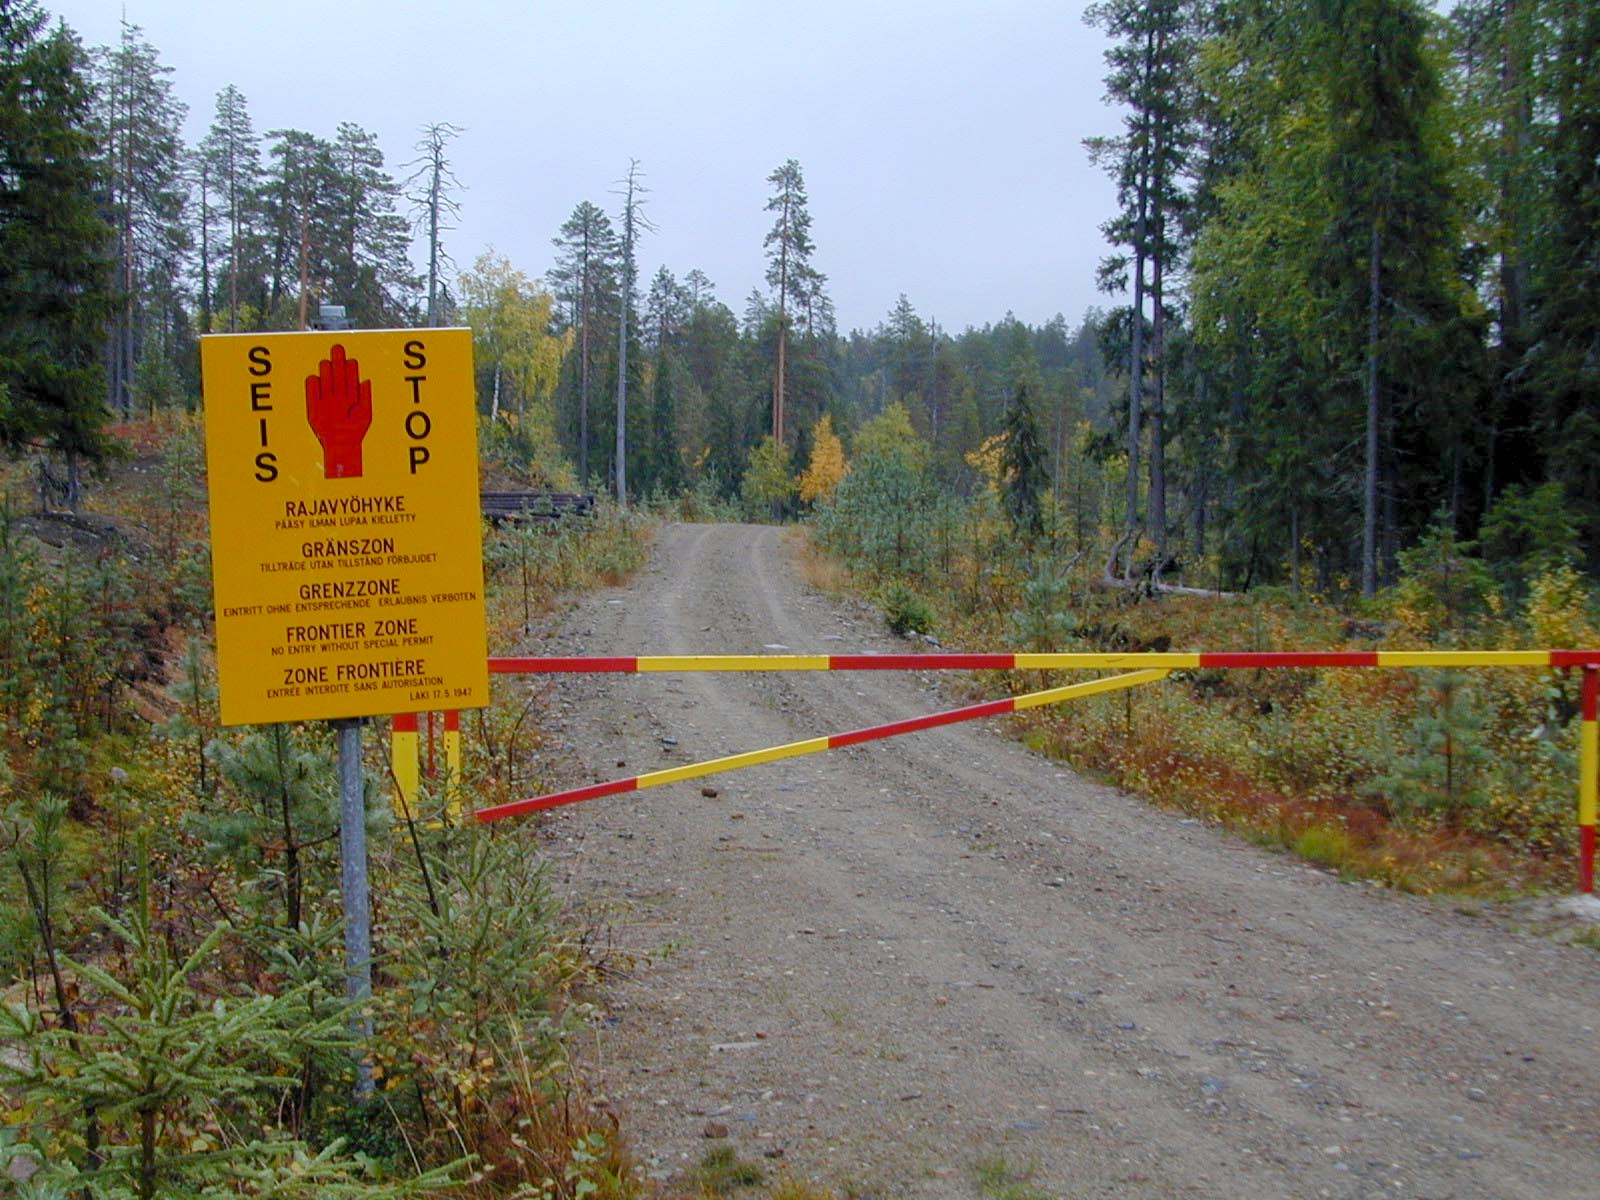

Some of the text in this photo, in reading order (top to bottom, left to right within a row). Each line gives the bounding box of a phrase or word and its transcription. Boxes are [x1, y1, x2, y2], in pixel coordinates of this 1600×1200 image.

[248, 347, 278, 482] SEIS
[403, 340, 431, 474] STOP
[285, 496, 405, 517] RAJAVYÖHYKE
[309, 517, 336, 528] ILMAN
[339, 515, 368, 526] LUPAA
[371, 513, 416, 524] KIELLETTY
[302, 538, 395, 558] GRÄNSZON
[310, 559, 333, 570] UTAN
[299, 579, 400, 600] GRENZZONE
[223, 592, 476, 617] EINTRITT OHNE ENTSPRECHENDE ERLAUBNIS VERBOTEN
[287, 619, 418, 643] FRONTIER ZONE
[271, 636, 434, 656] NO ENTRY WITHOUT SPECIAL PERMIT
[284, 666, 328, 685] ZONE
[305, 683, 348, 695] INTERDITE
[354, 681, 378, 691] SANS
[381, 677, 443, 689] AUTORISATION
[409, 691, 430, 701] LAKI
